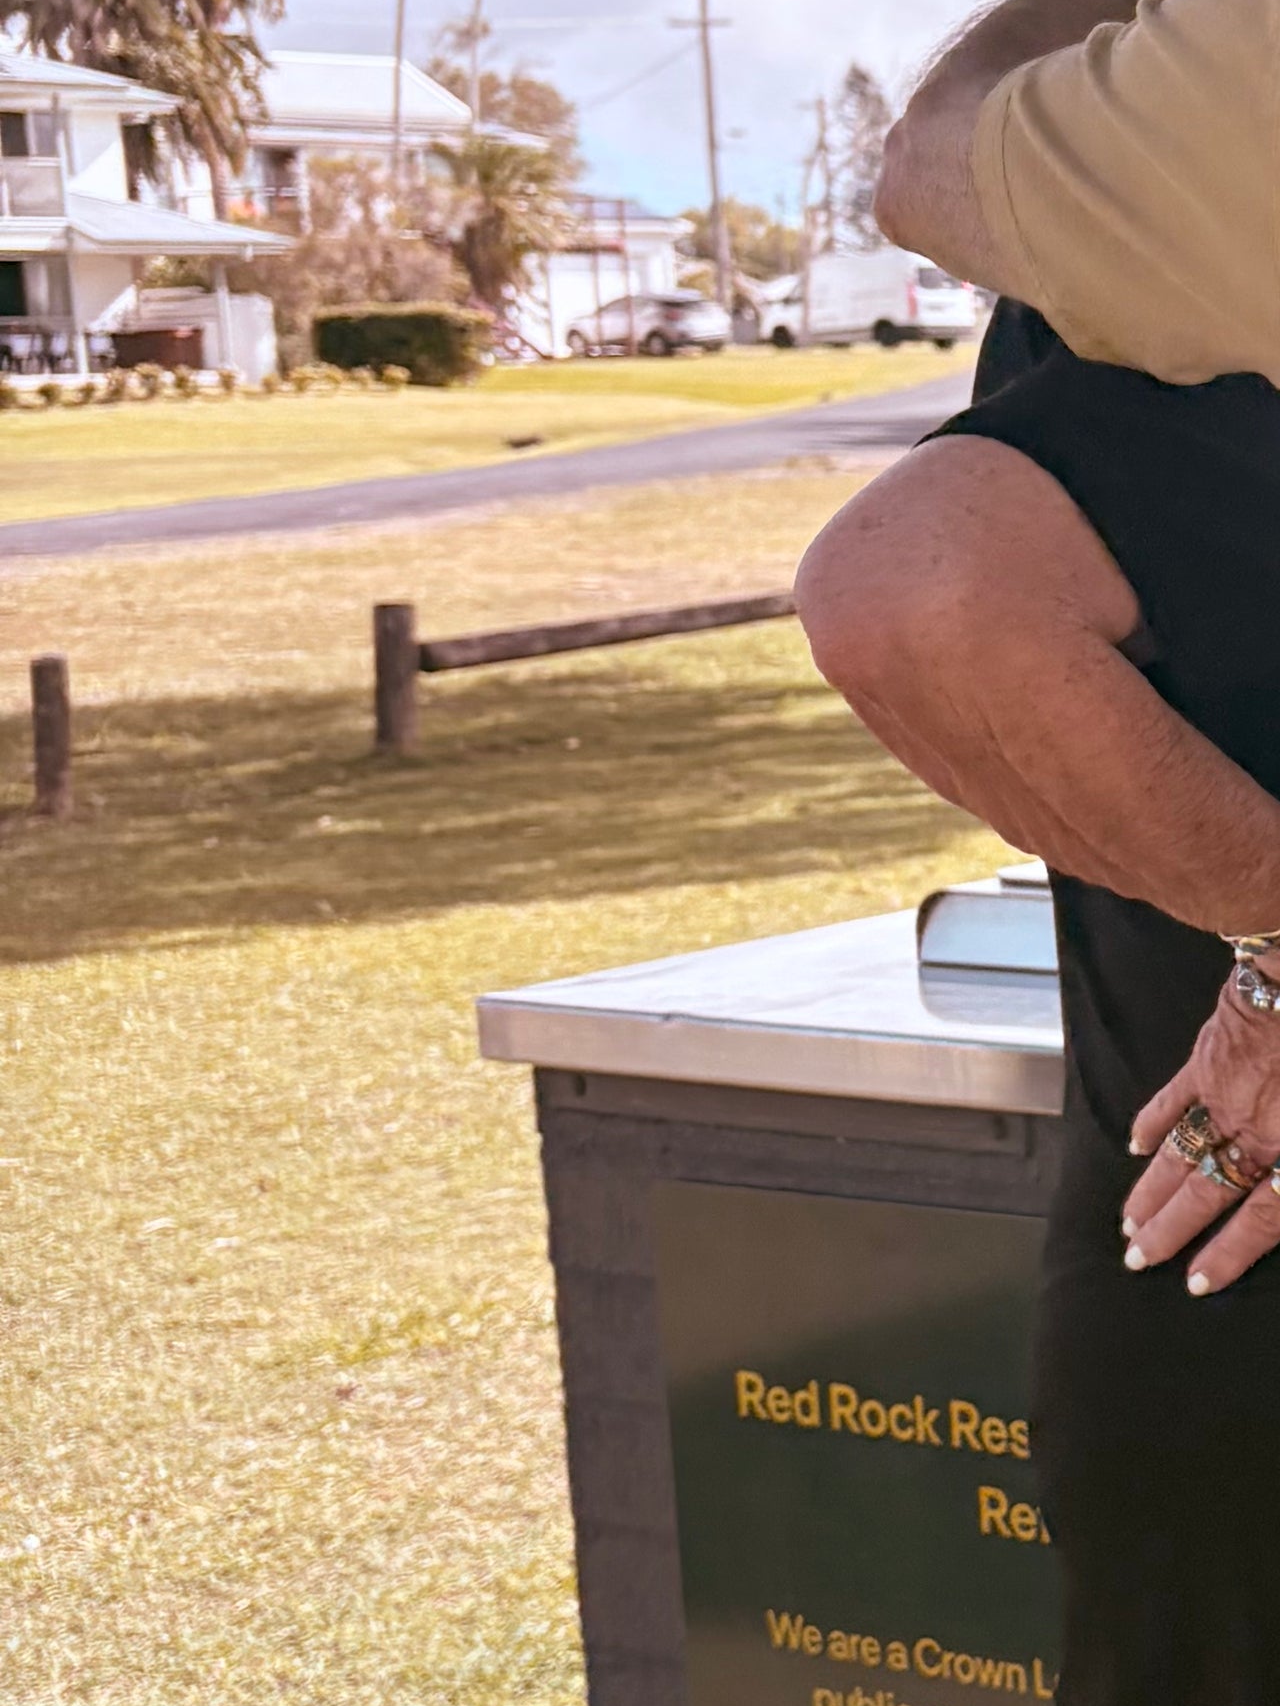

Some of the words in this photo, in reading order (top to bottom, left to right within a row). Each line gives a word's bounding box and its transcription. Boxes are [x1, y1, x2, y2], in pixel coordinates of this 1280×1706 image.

[735, 1370, 822, 1428] Red
[828, 1382, 941, 1447] Rock
[977, 1485, 1052, 1545] Re
[767, 1608, 824, 1659] We
[828, 1626, 883, 1667] are
[887, 1638, 909, 1673] a
[913, 1637, 1028, 1693] Crown
[1034, 1656, 1061, 1699] L
